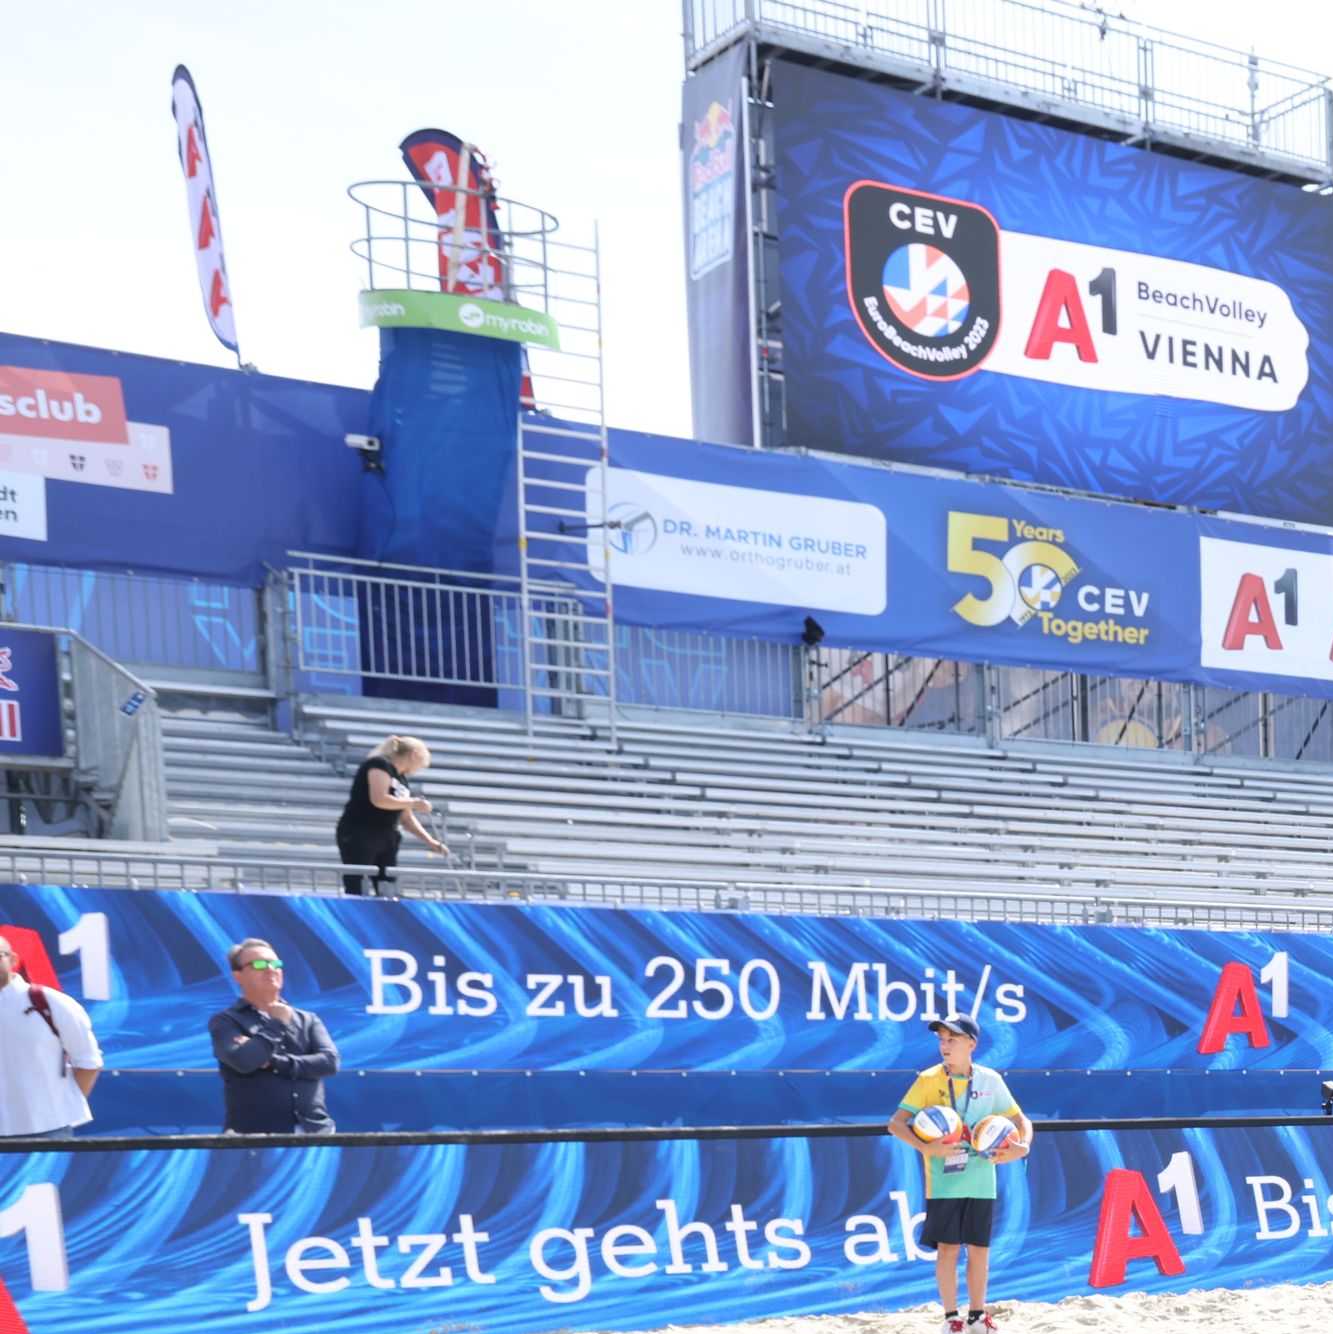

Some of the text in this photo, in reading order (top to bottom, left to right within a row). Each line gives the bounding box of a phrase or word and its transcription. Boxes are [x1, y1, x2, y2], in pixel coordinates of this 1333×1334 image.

[889, 202, 958, 239] CEV
[863, 296, 990, 363] EuroBeachVolley 2023
[1024, 267, 1117, 364] A1
[1137, 280, 1269, 329] BeachVolley
[1138, 328, 1280, 385] VIENNA
[663, 518, 867, 559] DR. MARTIN GRUBER
[1012, 518, 1065, 544] Years
[680, 544, 852, 576] www.orthogruber.at
[1038, 611, 1149, 645] Together
[1077, 584, 1149, 617] CEV
[1221, 567, 1298, 651] A1
[363, 948, 1027, 1024] Bis zu 250 Mbit/s
[1197, 951, 1288, 1054] A1
[1089, 1151, 1203, 1288] A1
[238, 1212, 495, 1312] Jetzt
[530, 1198, 811, 1303] gehts
